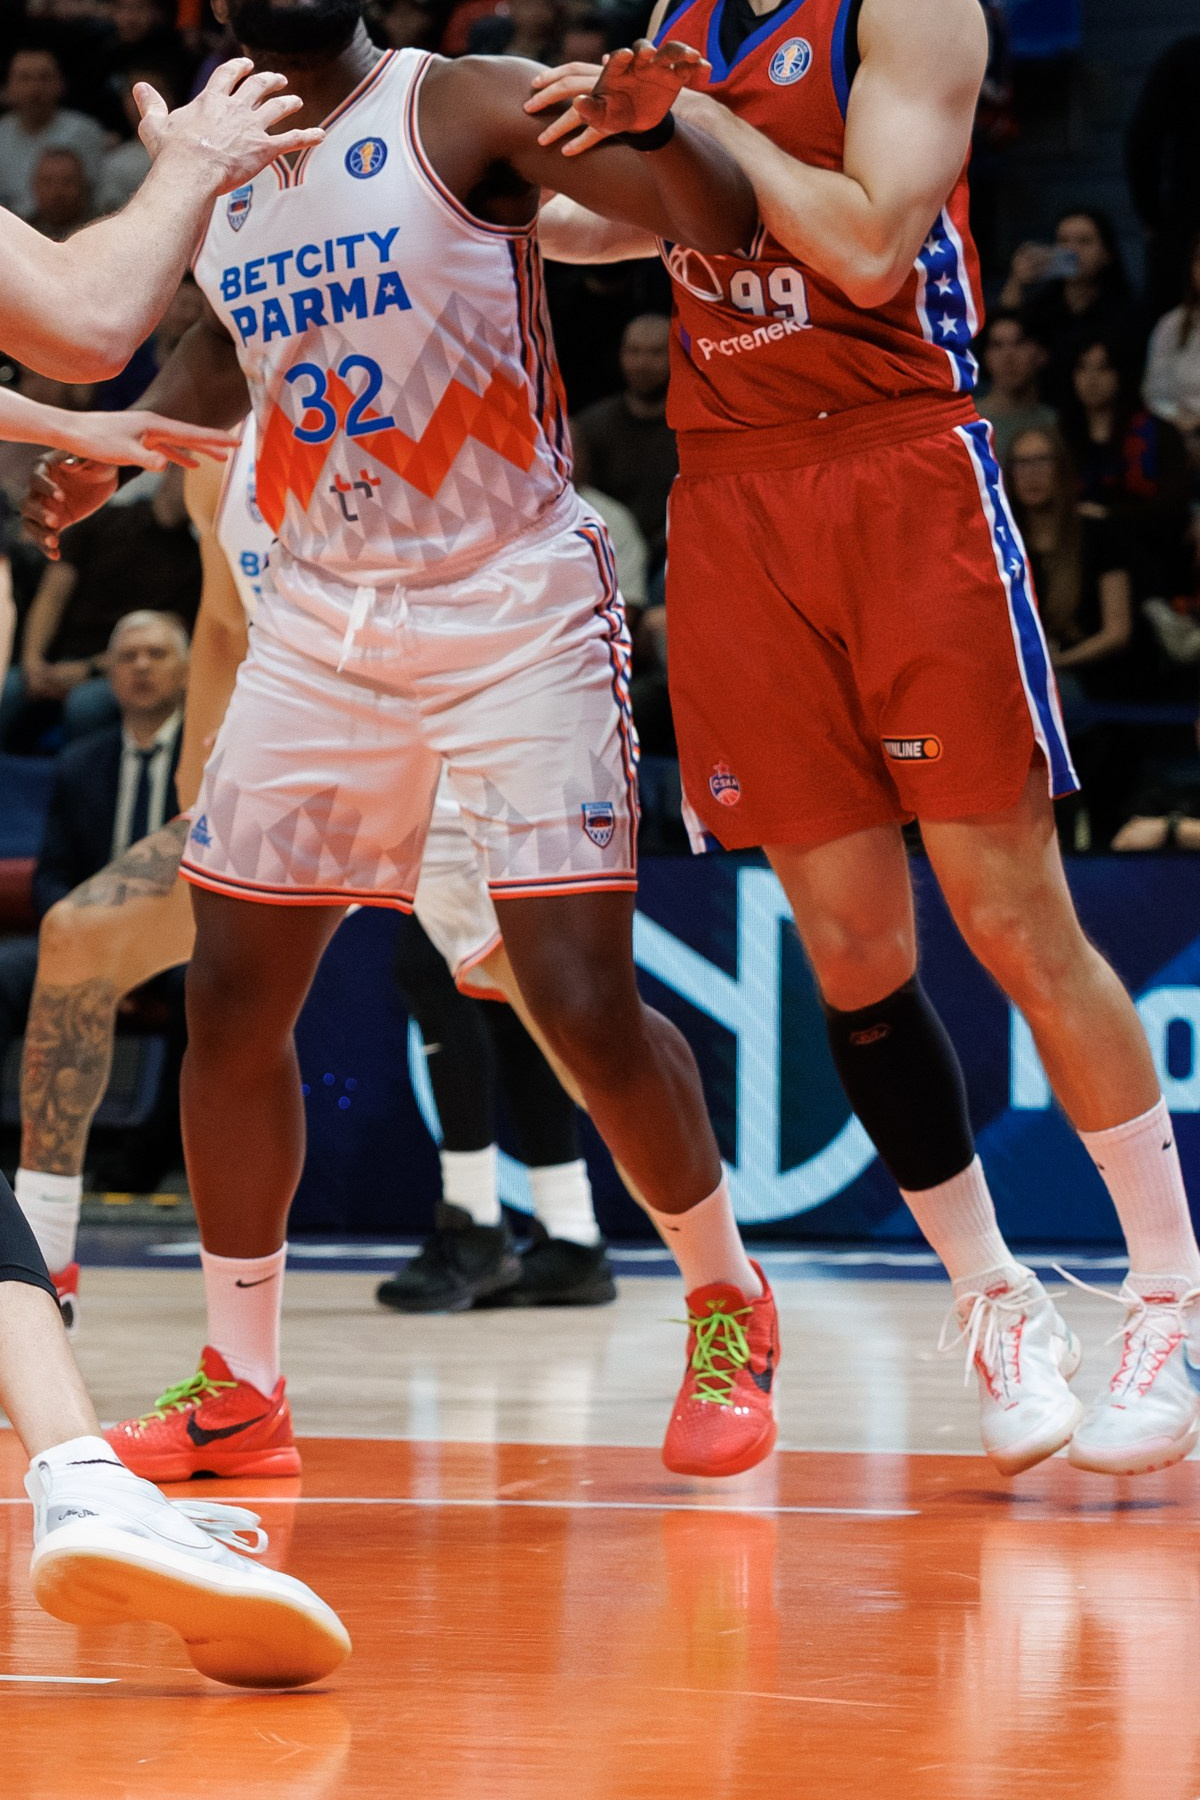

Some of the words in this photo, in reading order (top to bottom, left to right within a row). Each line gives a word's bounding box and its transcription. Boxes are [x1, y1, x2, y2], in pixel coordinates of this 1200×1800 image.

[219, 226, 401, 303] BETCITY
[729, 266, 809, 325] 99
[230, 270, 413, 349] PARMA
[696, 319, 813, 361] Рстелек
[283, 353, 397, 445] 32
